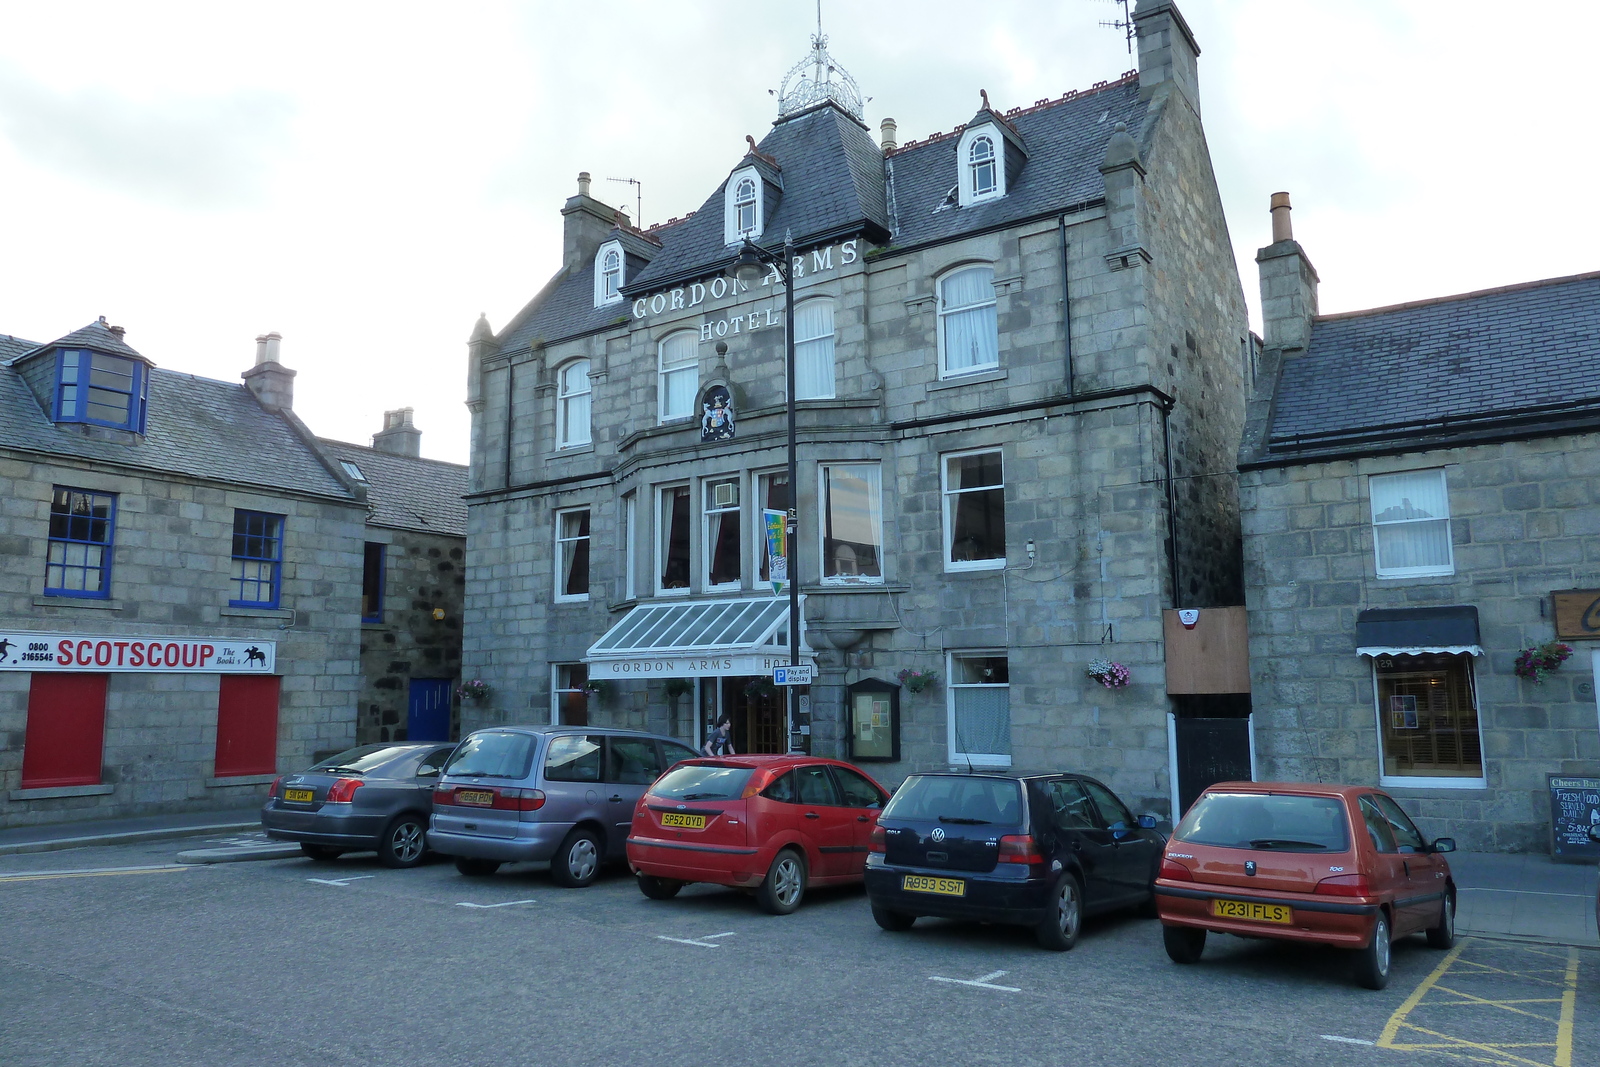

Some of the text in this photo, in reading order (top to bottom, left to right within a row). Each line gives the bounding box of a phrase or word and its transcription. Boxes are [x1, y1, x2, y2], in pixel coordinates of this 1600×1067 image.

[762, 239, 857, 286] ARMS
[700, 308, 779, 341] HOTEL
[29, 642, 49, 651] 0800
[57, 639, 214, 667] SCOTSCOUP
[223, 648, 235, 656] The
[612, 661, 675, 673] GORDON
[688, 659, 732, 671] ARMS
[788, 675, 809, 683] display
[1552, 779, 1599, 788] Cheers Bar
[1556, 789, 1600, 805] FRESH FOOD
[1560, 801, 1585, 811] SERVED
[664, 814, 702, 827] SP52 OYD
[1563, 810, 1584, 819] DAILY
[905, 877, 963, 893] R993 SST
[1217, 901, 1250, 917] Y231
[1253, 905, 1284, 920] FLS
